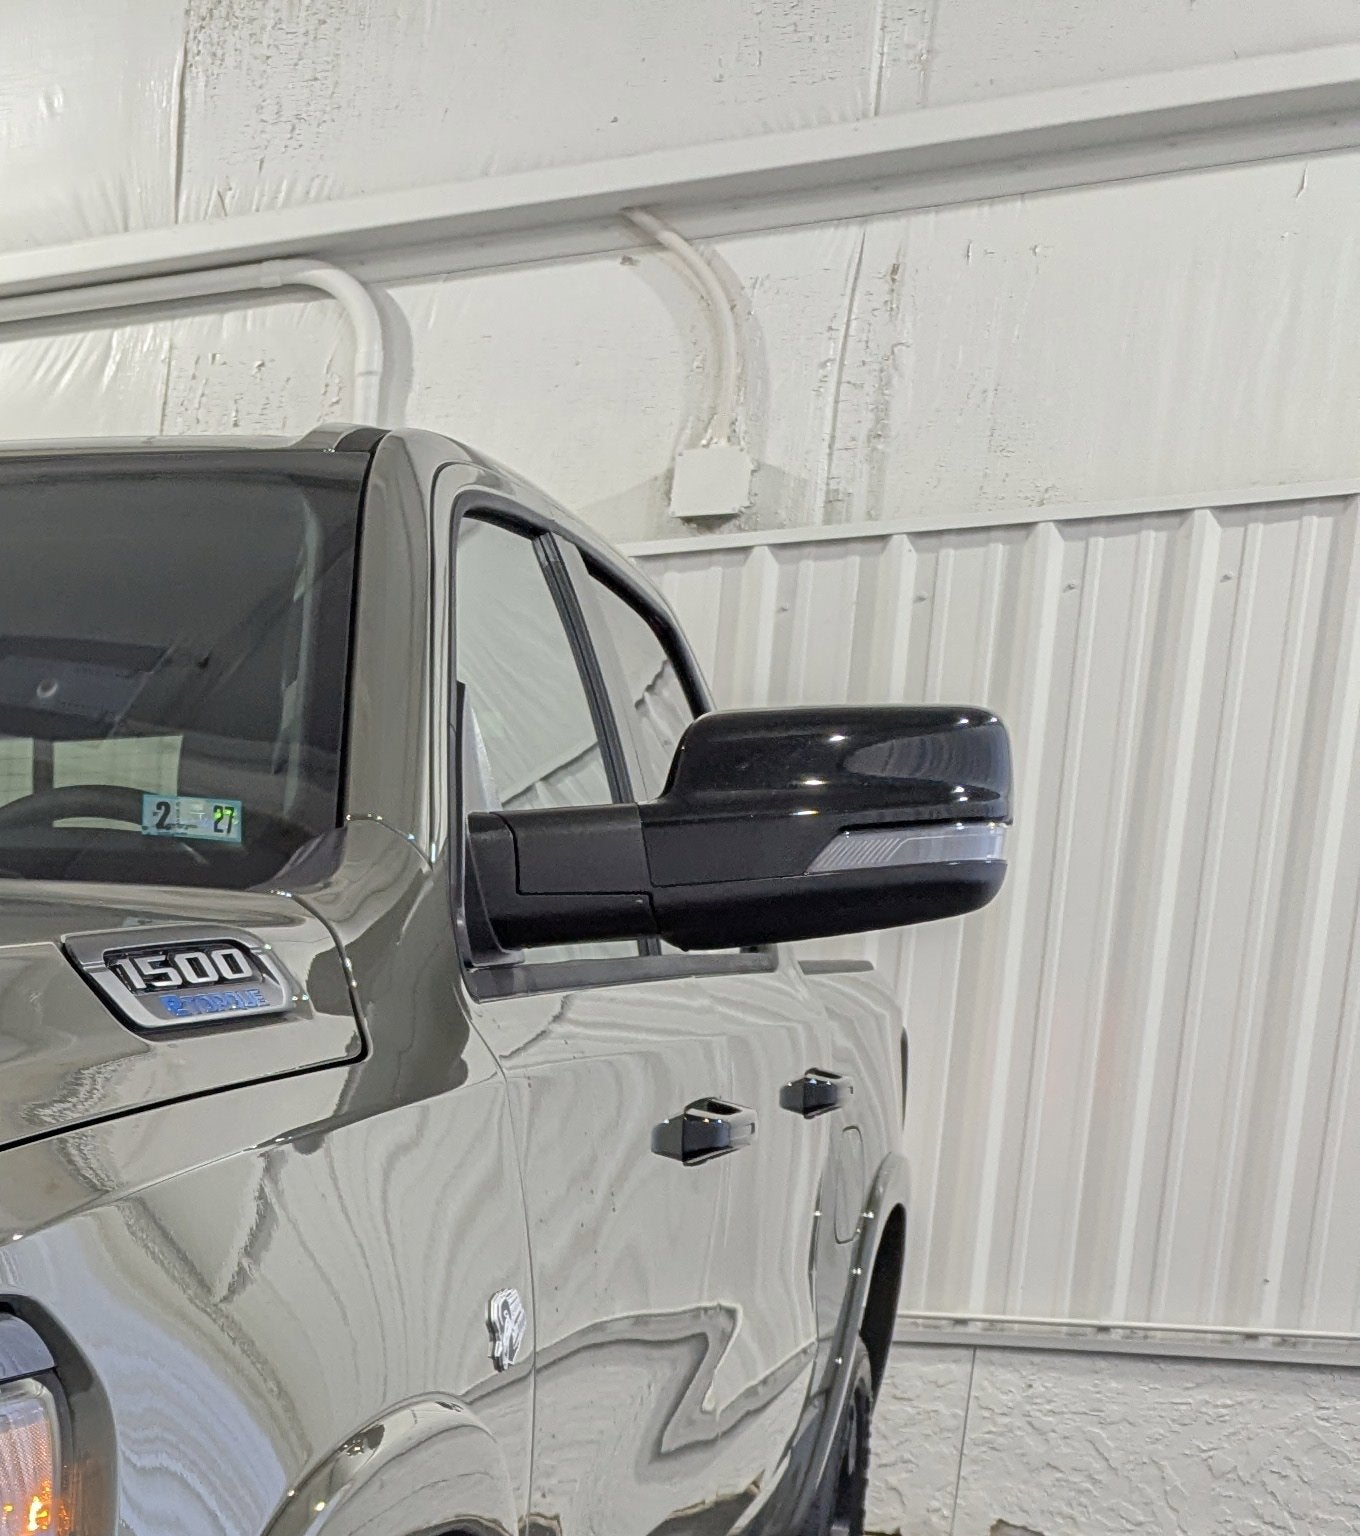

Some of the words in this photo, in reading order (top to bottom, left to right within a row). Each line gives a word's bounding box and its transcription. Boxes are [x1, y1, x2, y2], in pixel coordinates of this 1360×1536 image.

[155, 801, 171, 830] 2
[213, 805, 235, 834] 27
[111, 947, 253, 990] 1500
